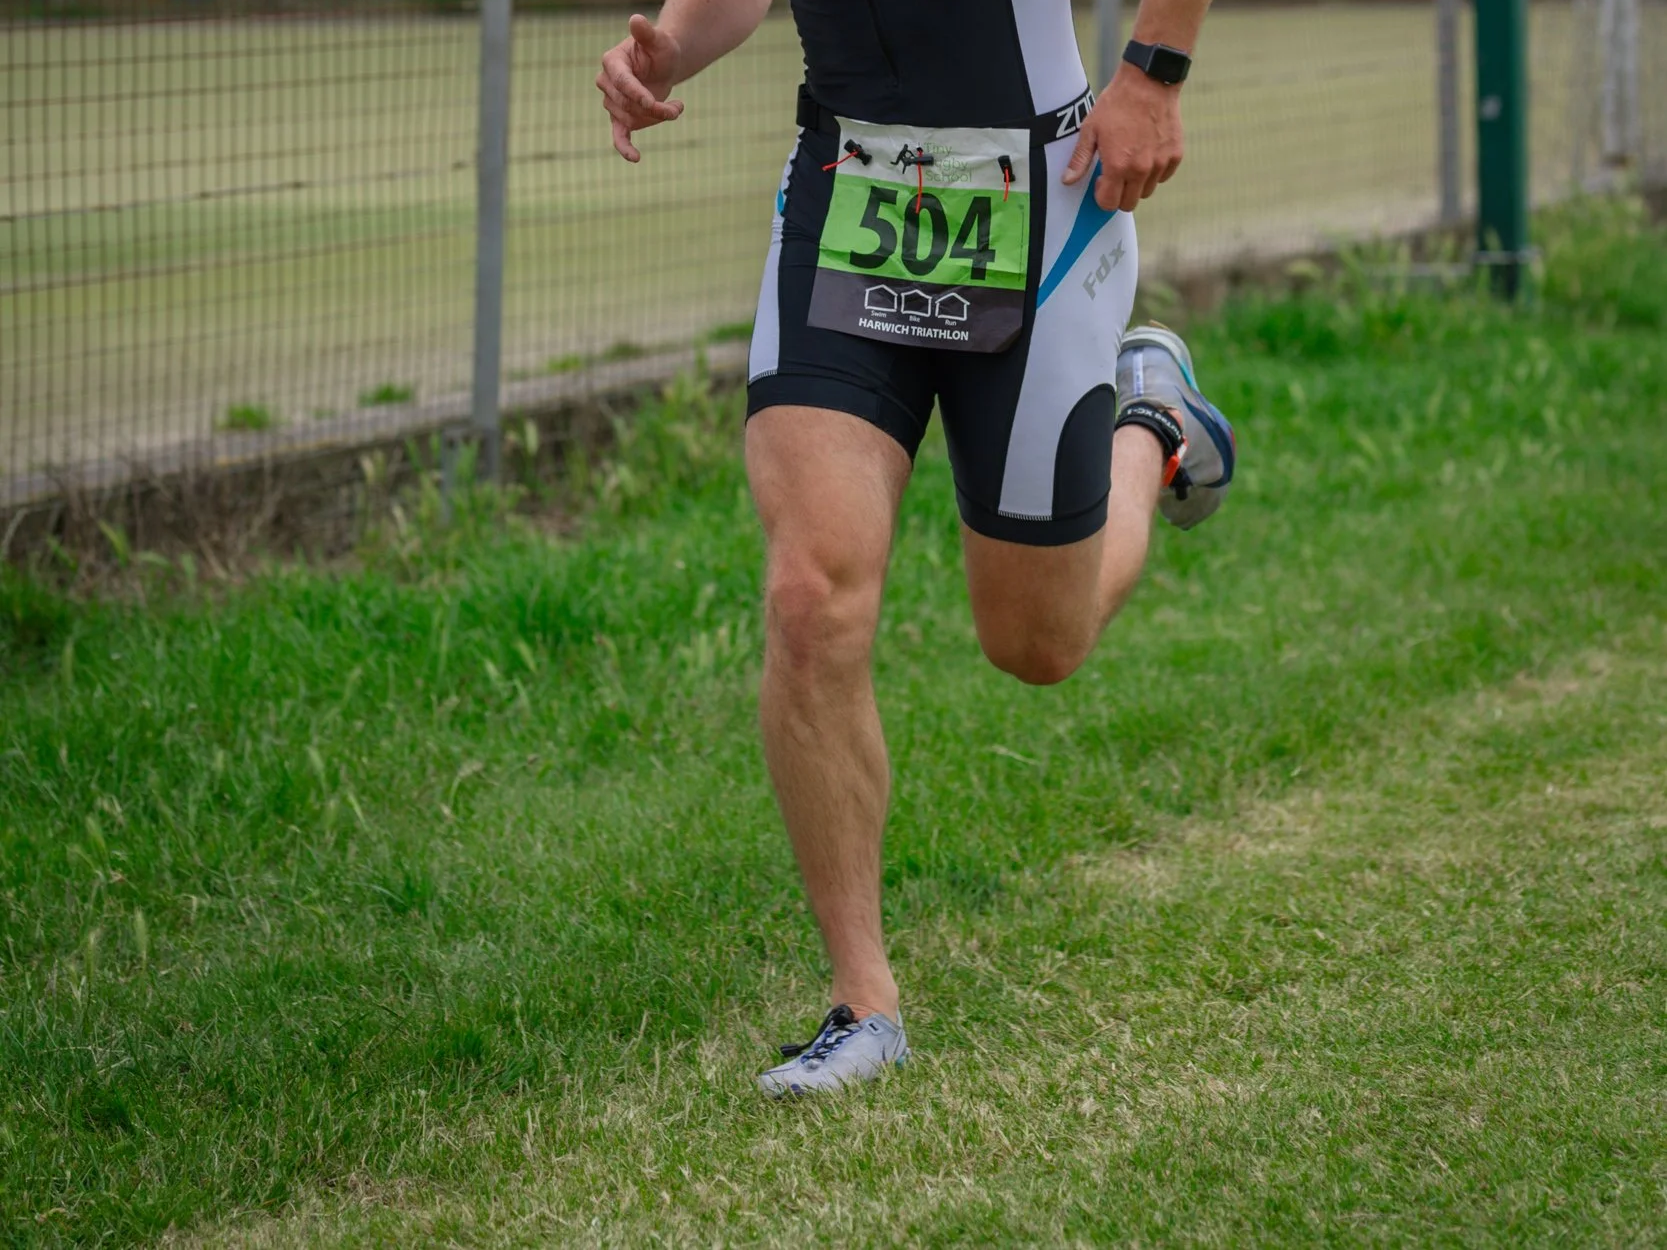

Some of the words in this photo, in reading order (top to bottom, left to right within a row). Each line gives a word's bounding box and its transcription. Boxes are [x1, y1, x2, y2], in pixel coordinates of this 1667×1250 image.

[925, 169, 972, 183] School
[849, 186, 996, 280] 504
[1082, 238, 1126, 301] Fdx
[870, 310, 887, 318] Swim
[909, 315, 921, 323] Bike
[858, 317, 909, 335] HARWICH
[910, 326, 969, 341] TRIATHLON
